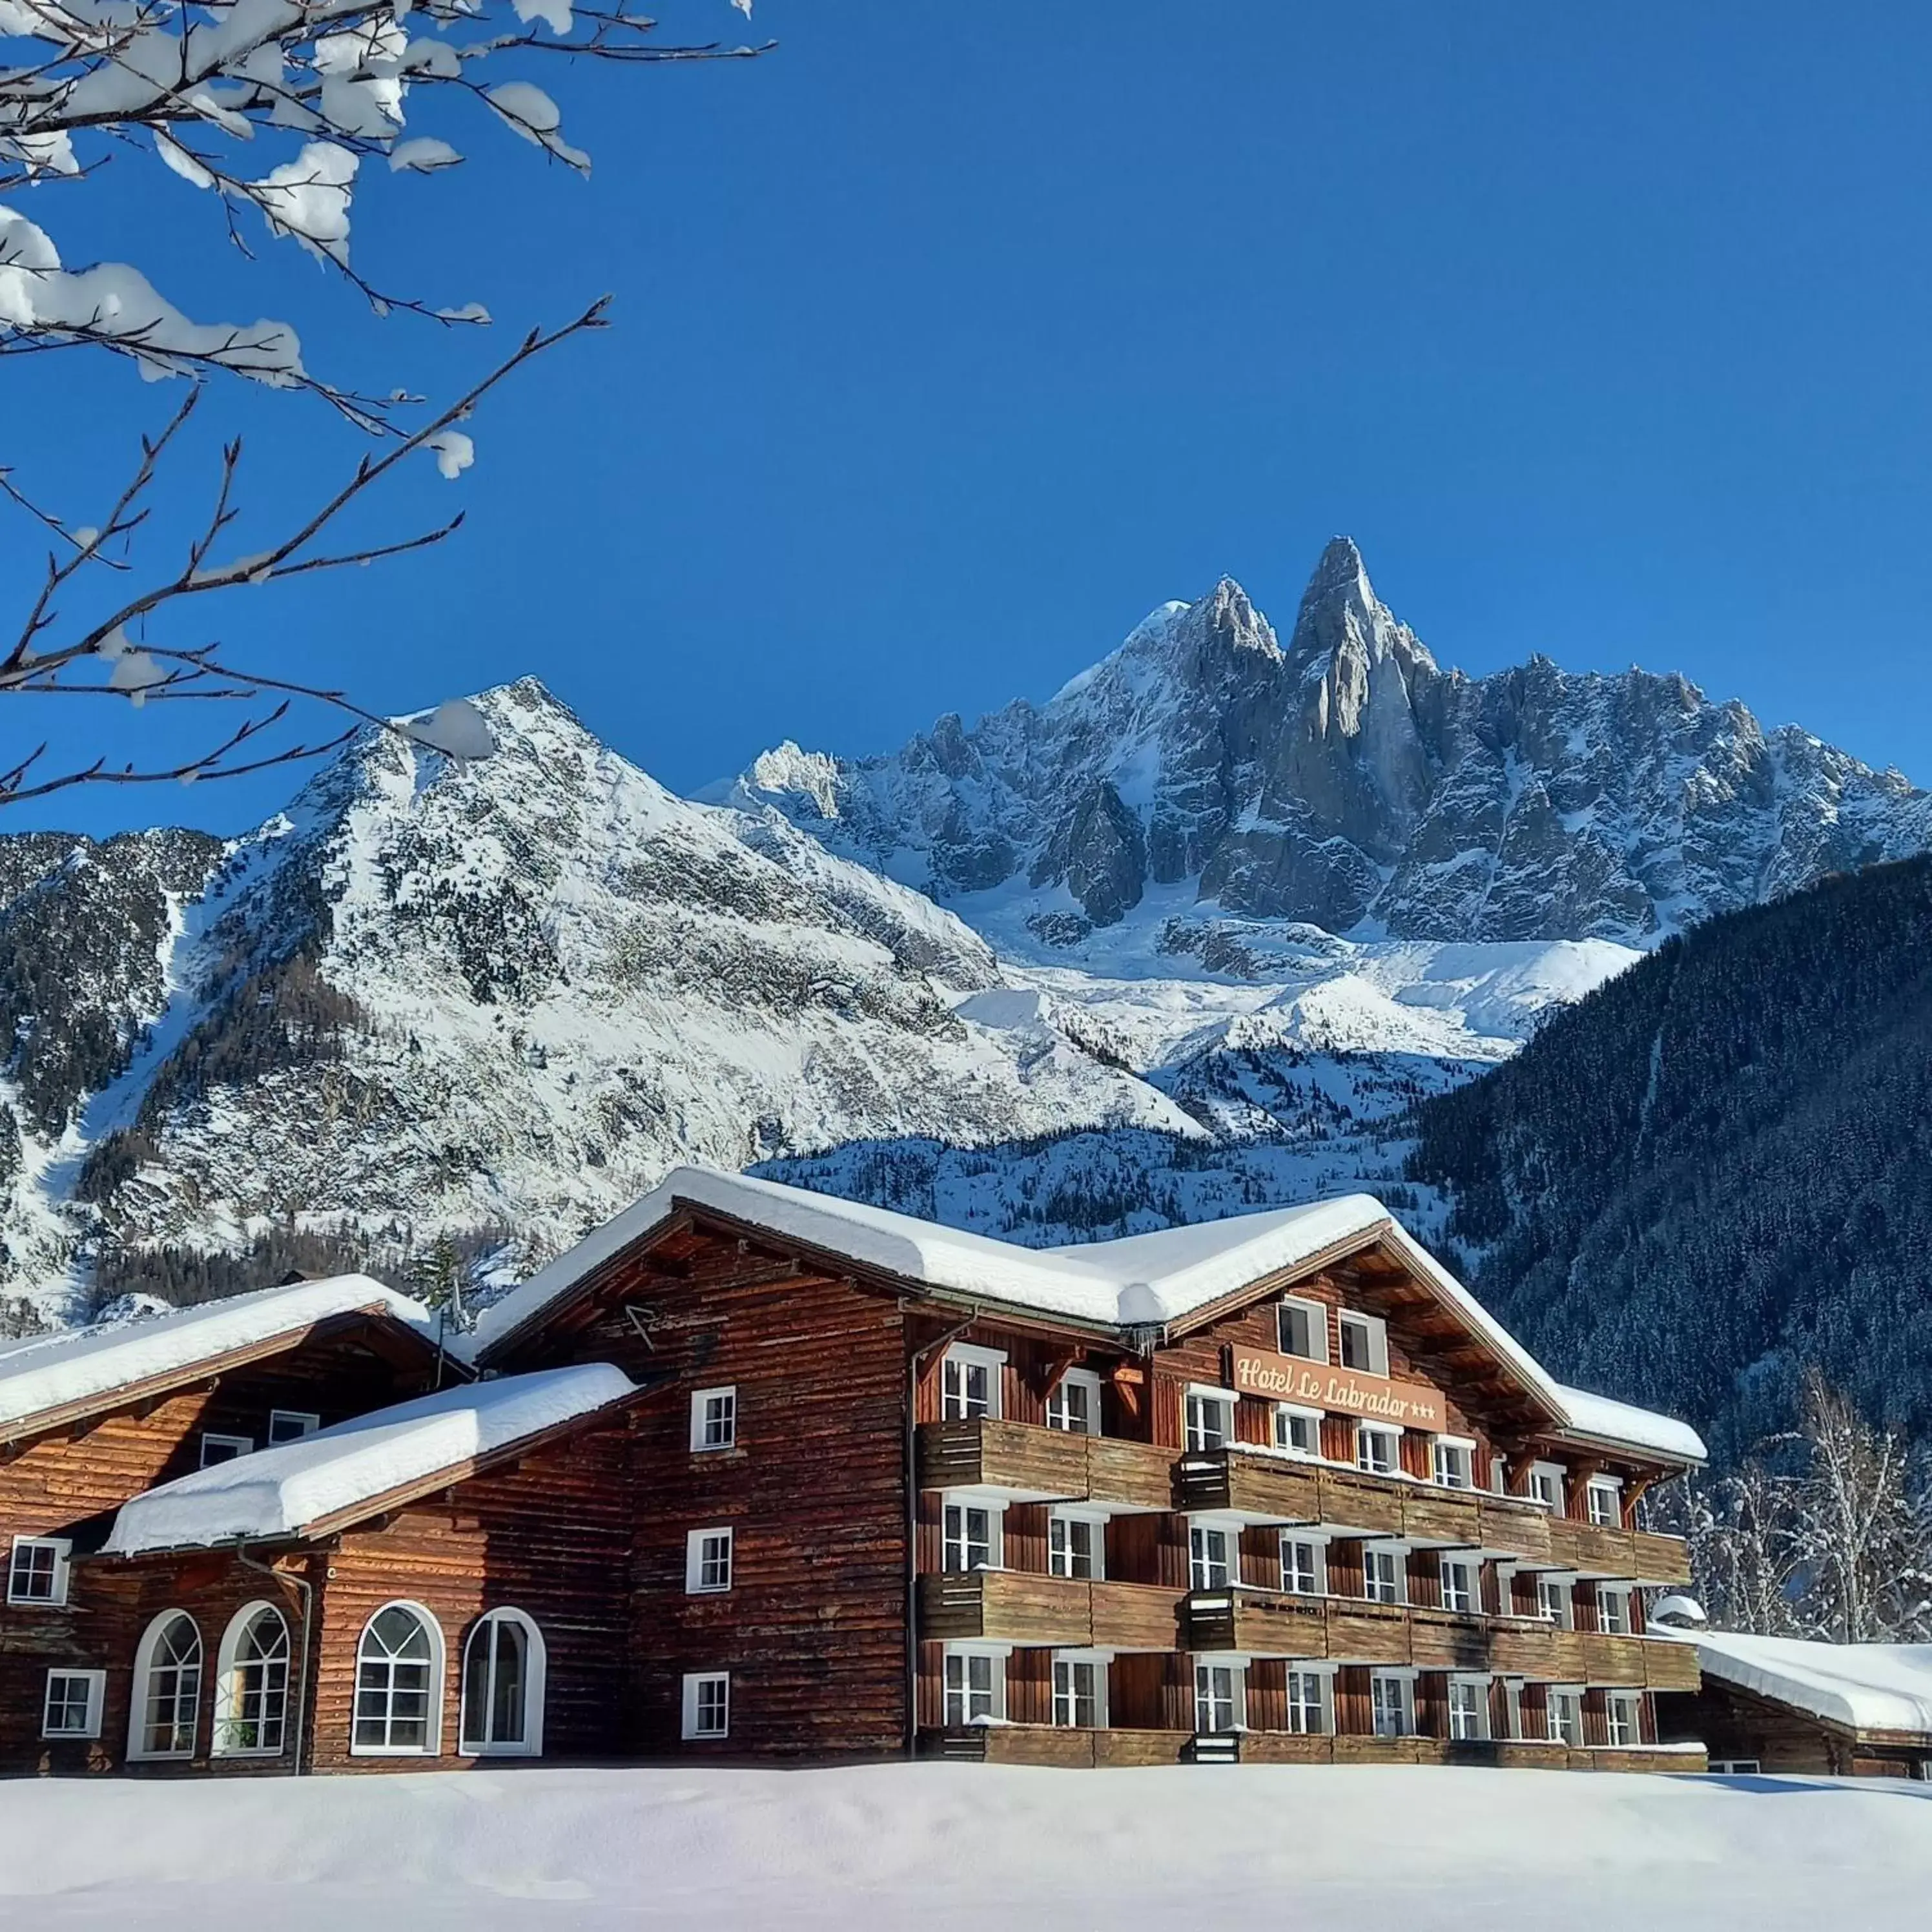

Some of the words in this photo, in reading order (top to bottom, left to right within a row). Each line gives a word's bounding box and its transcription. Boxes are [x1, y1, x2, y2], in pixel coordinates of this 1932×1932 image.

[1237, 1358, 1295, 1393] Hotel
[1297, 1372, 1322, 1399] Le
[1324, 1378, 1409, 1417] Labrador
